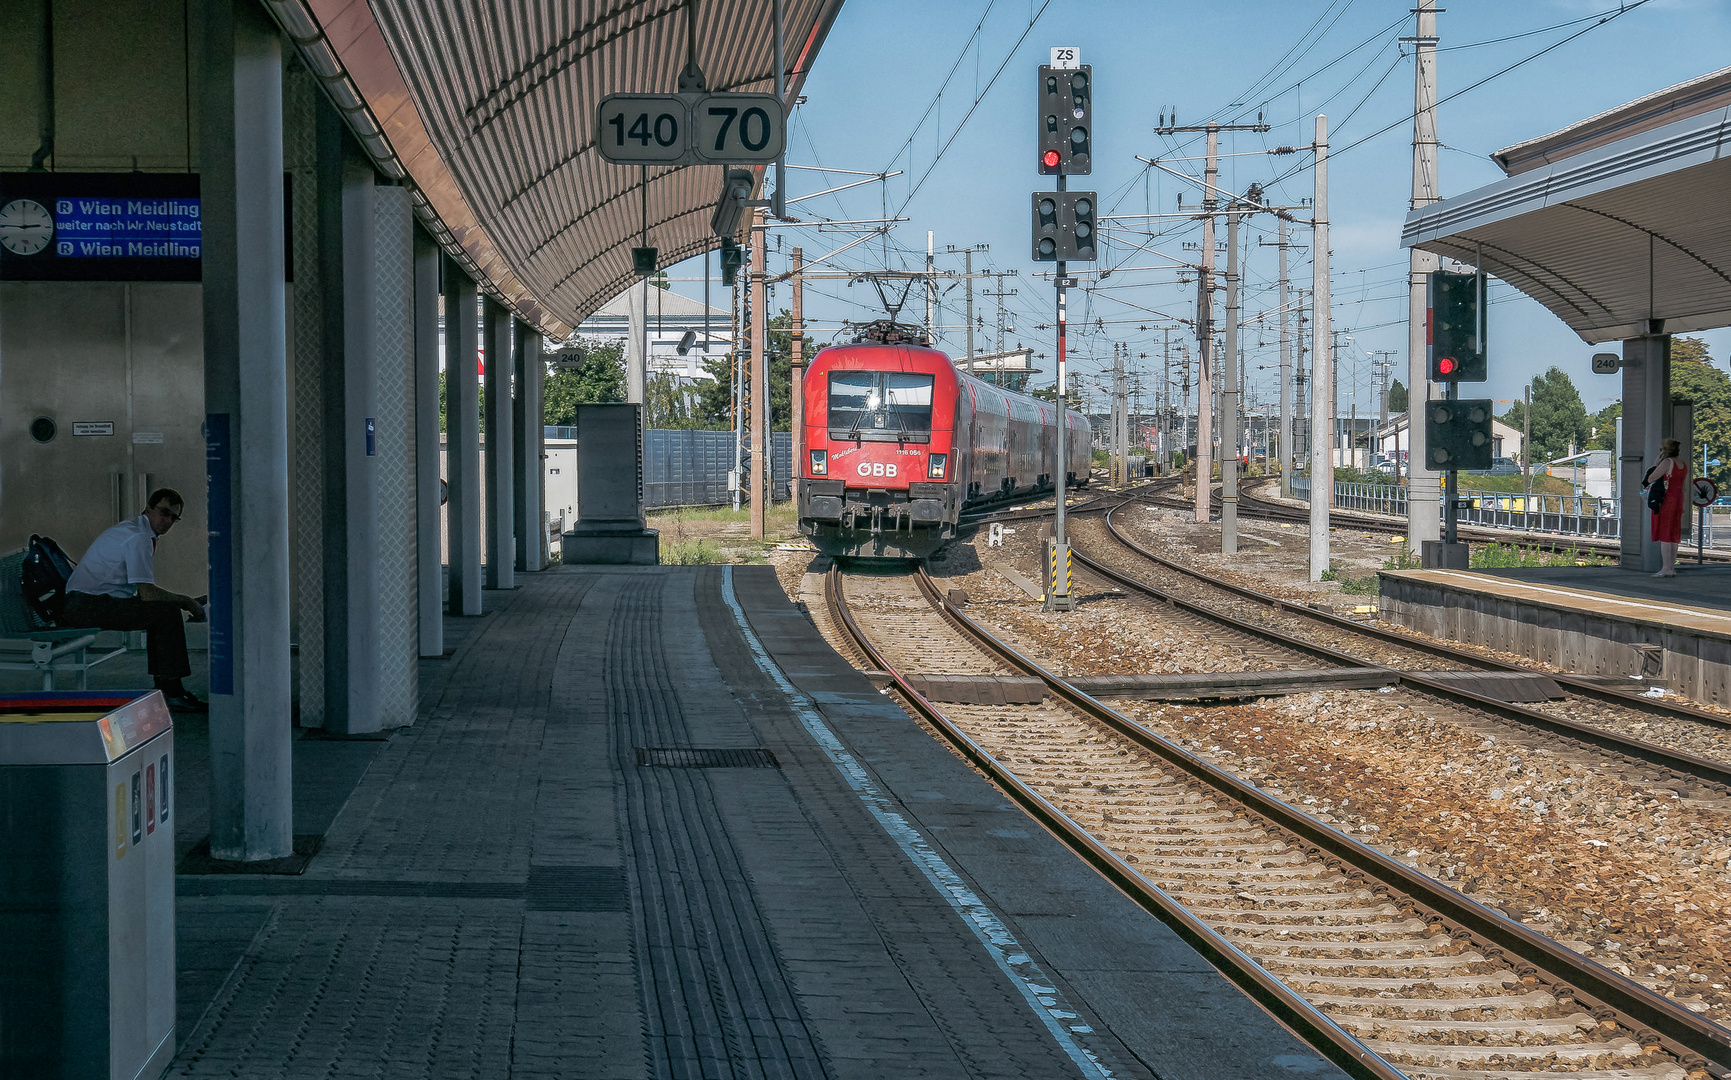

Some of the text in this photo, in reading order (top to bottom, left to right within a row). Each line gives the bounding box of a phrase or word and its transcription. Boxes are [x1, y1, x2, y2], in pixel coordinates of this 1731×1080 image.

[1057, 49, 1074, 60] ZS
[608, 112, 678, 147] 140
[707, 106, 771, 152] 70
[79, 201, 122, 215] Wien
[128, 201, 199, 217] Meidling
[56, 220, 94, 231] weiter
[95, 220, 123, 231] nach
[80, 241, 122, 255] Wien
[128, 241, 200, 258] Meidling
[561, 353, 580, 363] 240
[1596, 359, 1615, 368] 240
[857, 462, 898, 477] ÖBB
